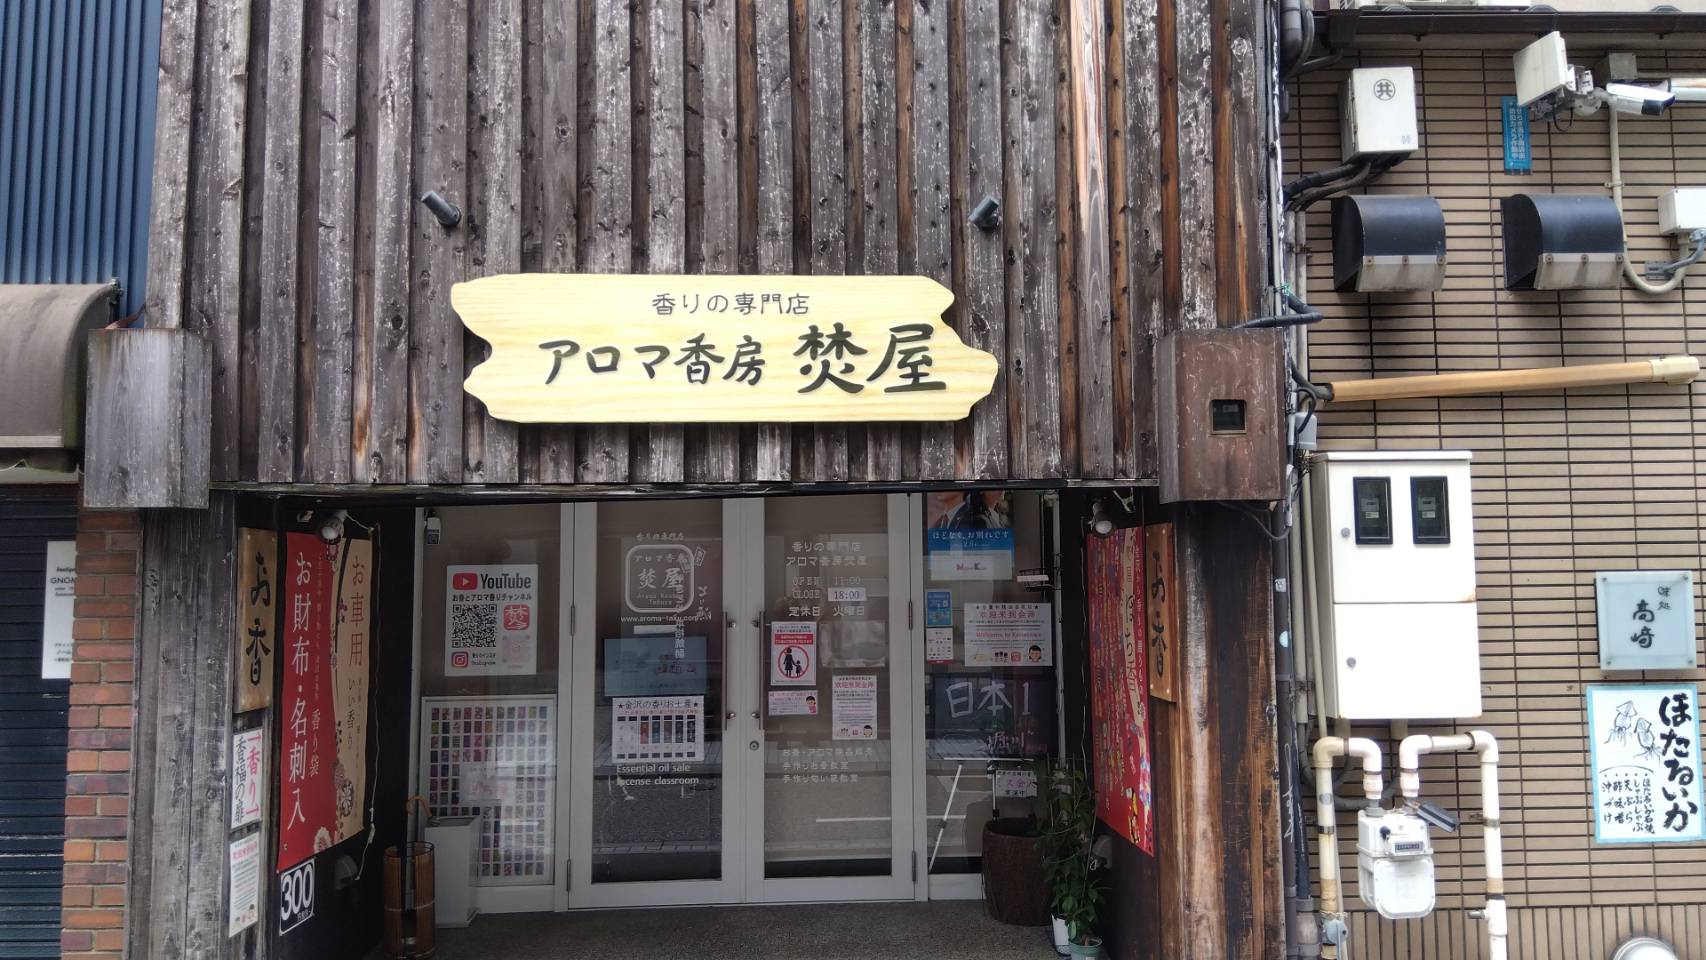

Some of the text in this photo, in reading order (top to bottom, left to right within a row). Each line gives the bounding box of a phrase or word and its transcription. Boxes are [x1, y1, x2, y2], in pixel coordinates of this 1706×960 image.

[651, 292, 811, 316] 香りの専門店
[538, 321, 948, 395] アロマ香房 焚屋
[480, 573, 532, 589] YouTube
[834, 590, 860, 600] 18:00
[245, 551, 271, 686] お香
[349, 554, 365, 668] お車用
[788, 605, 821, 617] 定休日
[1151, 551, 1168, 679] お香
[310, 708, 321, 778] 香り袋
[616, 763, 691, 773] Essential oil sale
[1659, 692, 1698, 833] ほたるいか
[654, 776, 700, 785] classroom
[281, 863, 313, 921] 300
